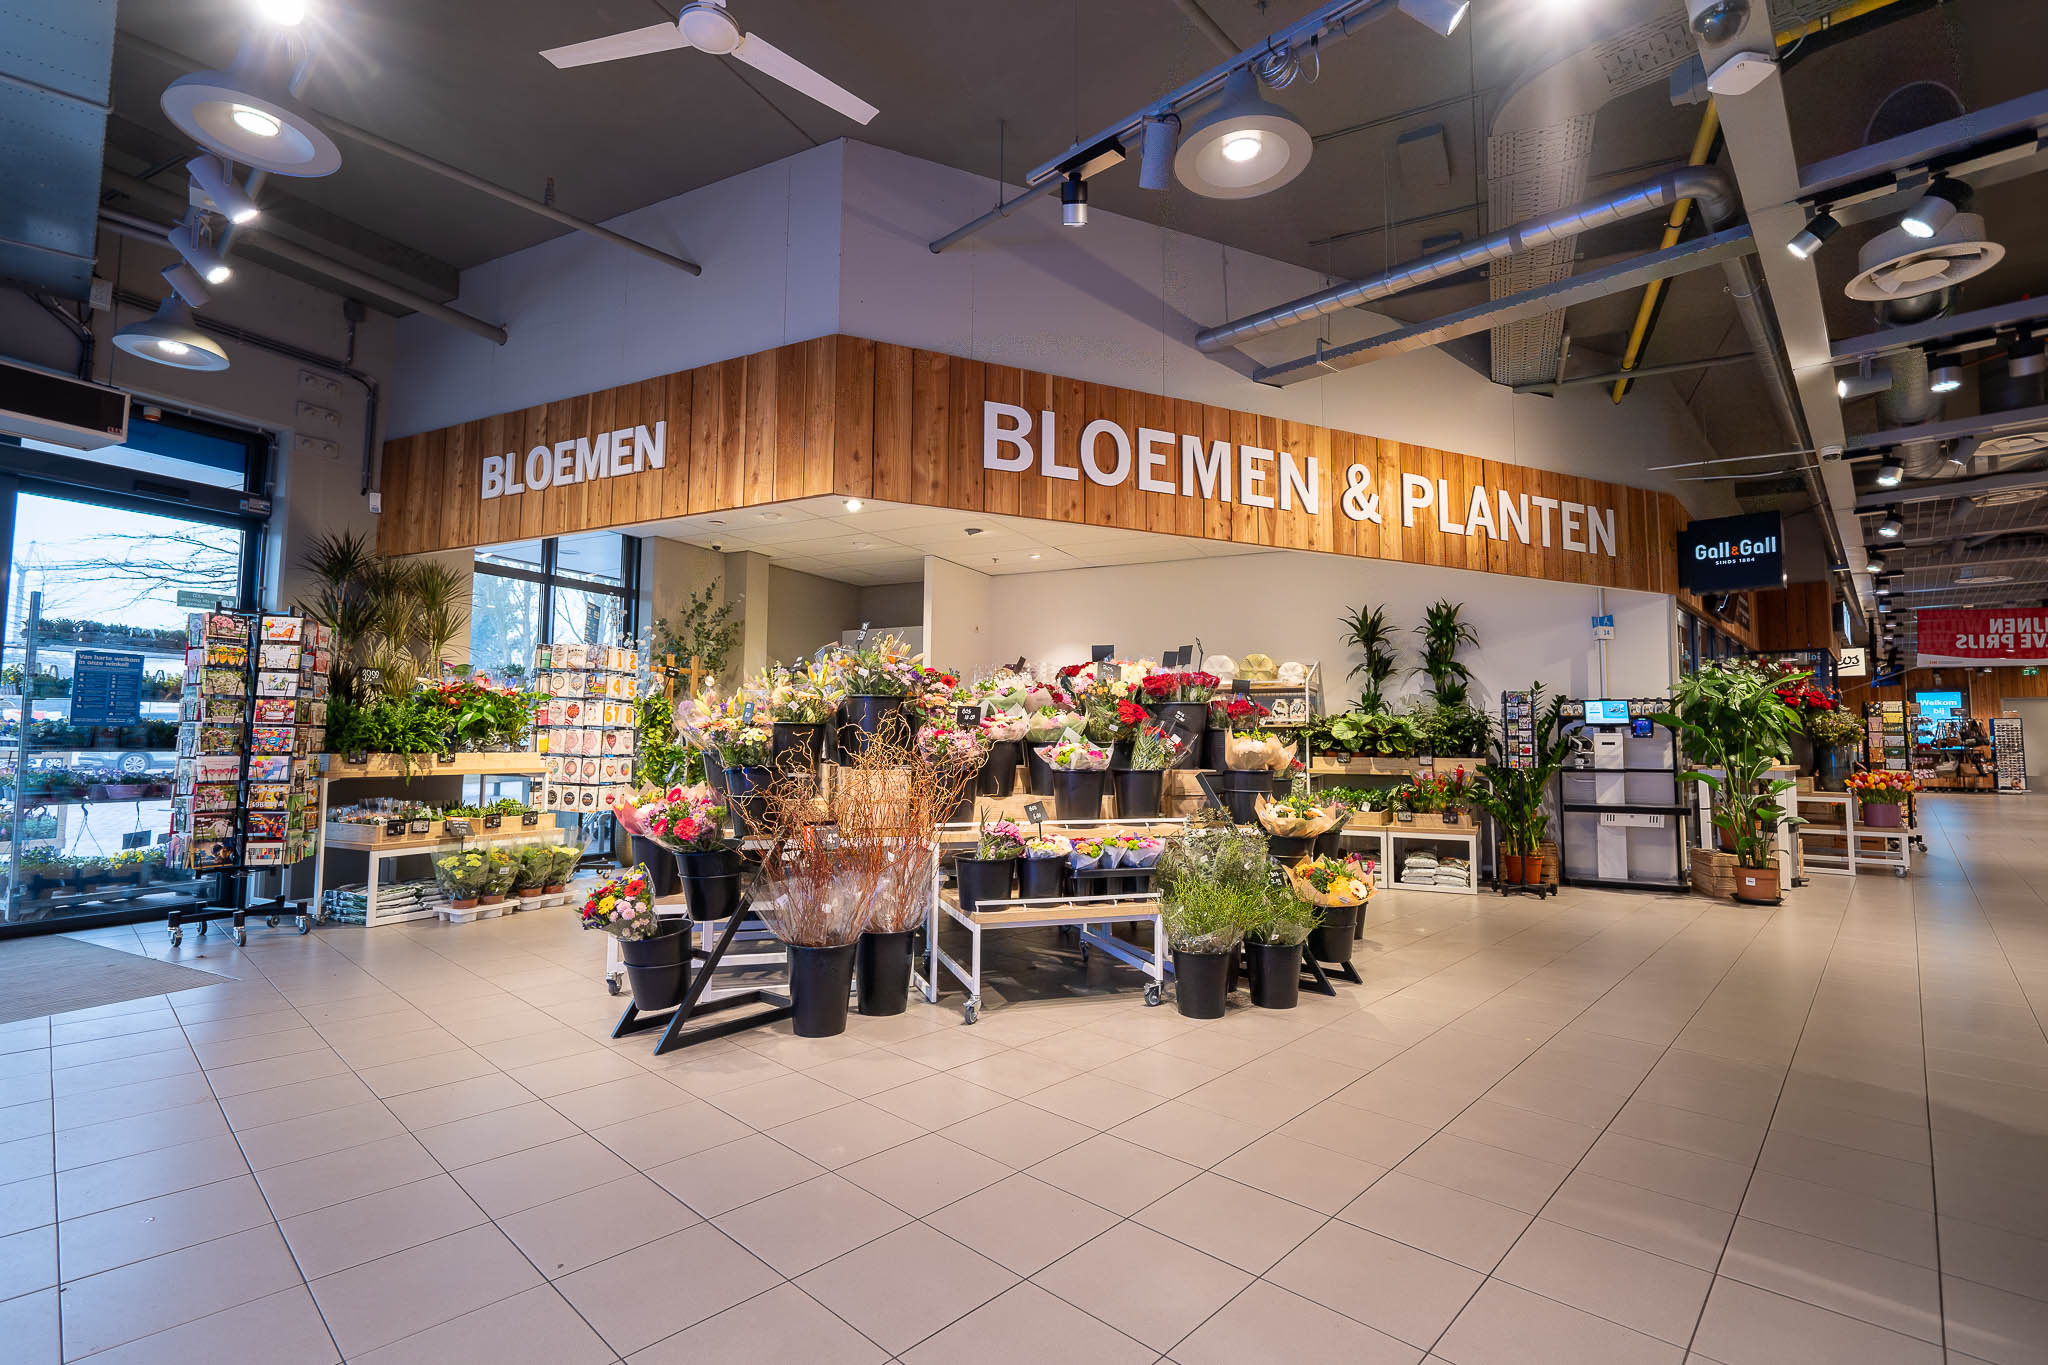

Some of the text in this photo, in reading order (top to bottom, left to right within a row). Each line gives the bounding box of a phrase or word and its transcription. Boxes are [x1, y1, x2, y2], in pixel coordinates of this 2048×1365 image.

[481, 420, 667, 500] BLOEMEN
[984, 400, 1616, 556] BLOEMEN & PLANTEN
[1695, 536, 1776, 560] Gall&Gall
[361, 669, 380, 682] 39.99
